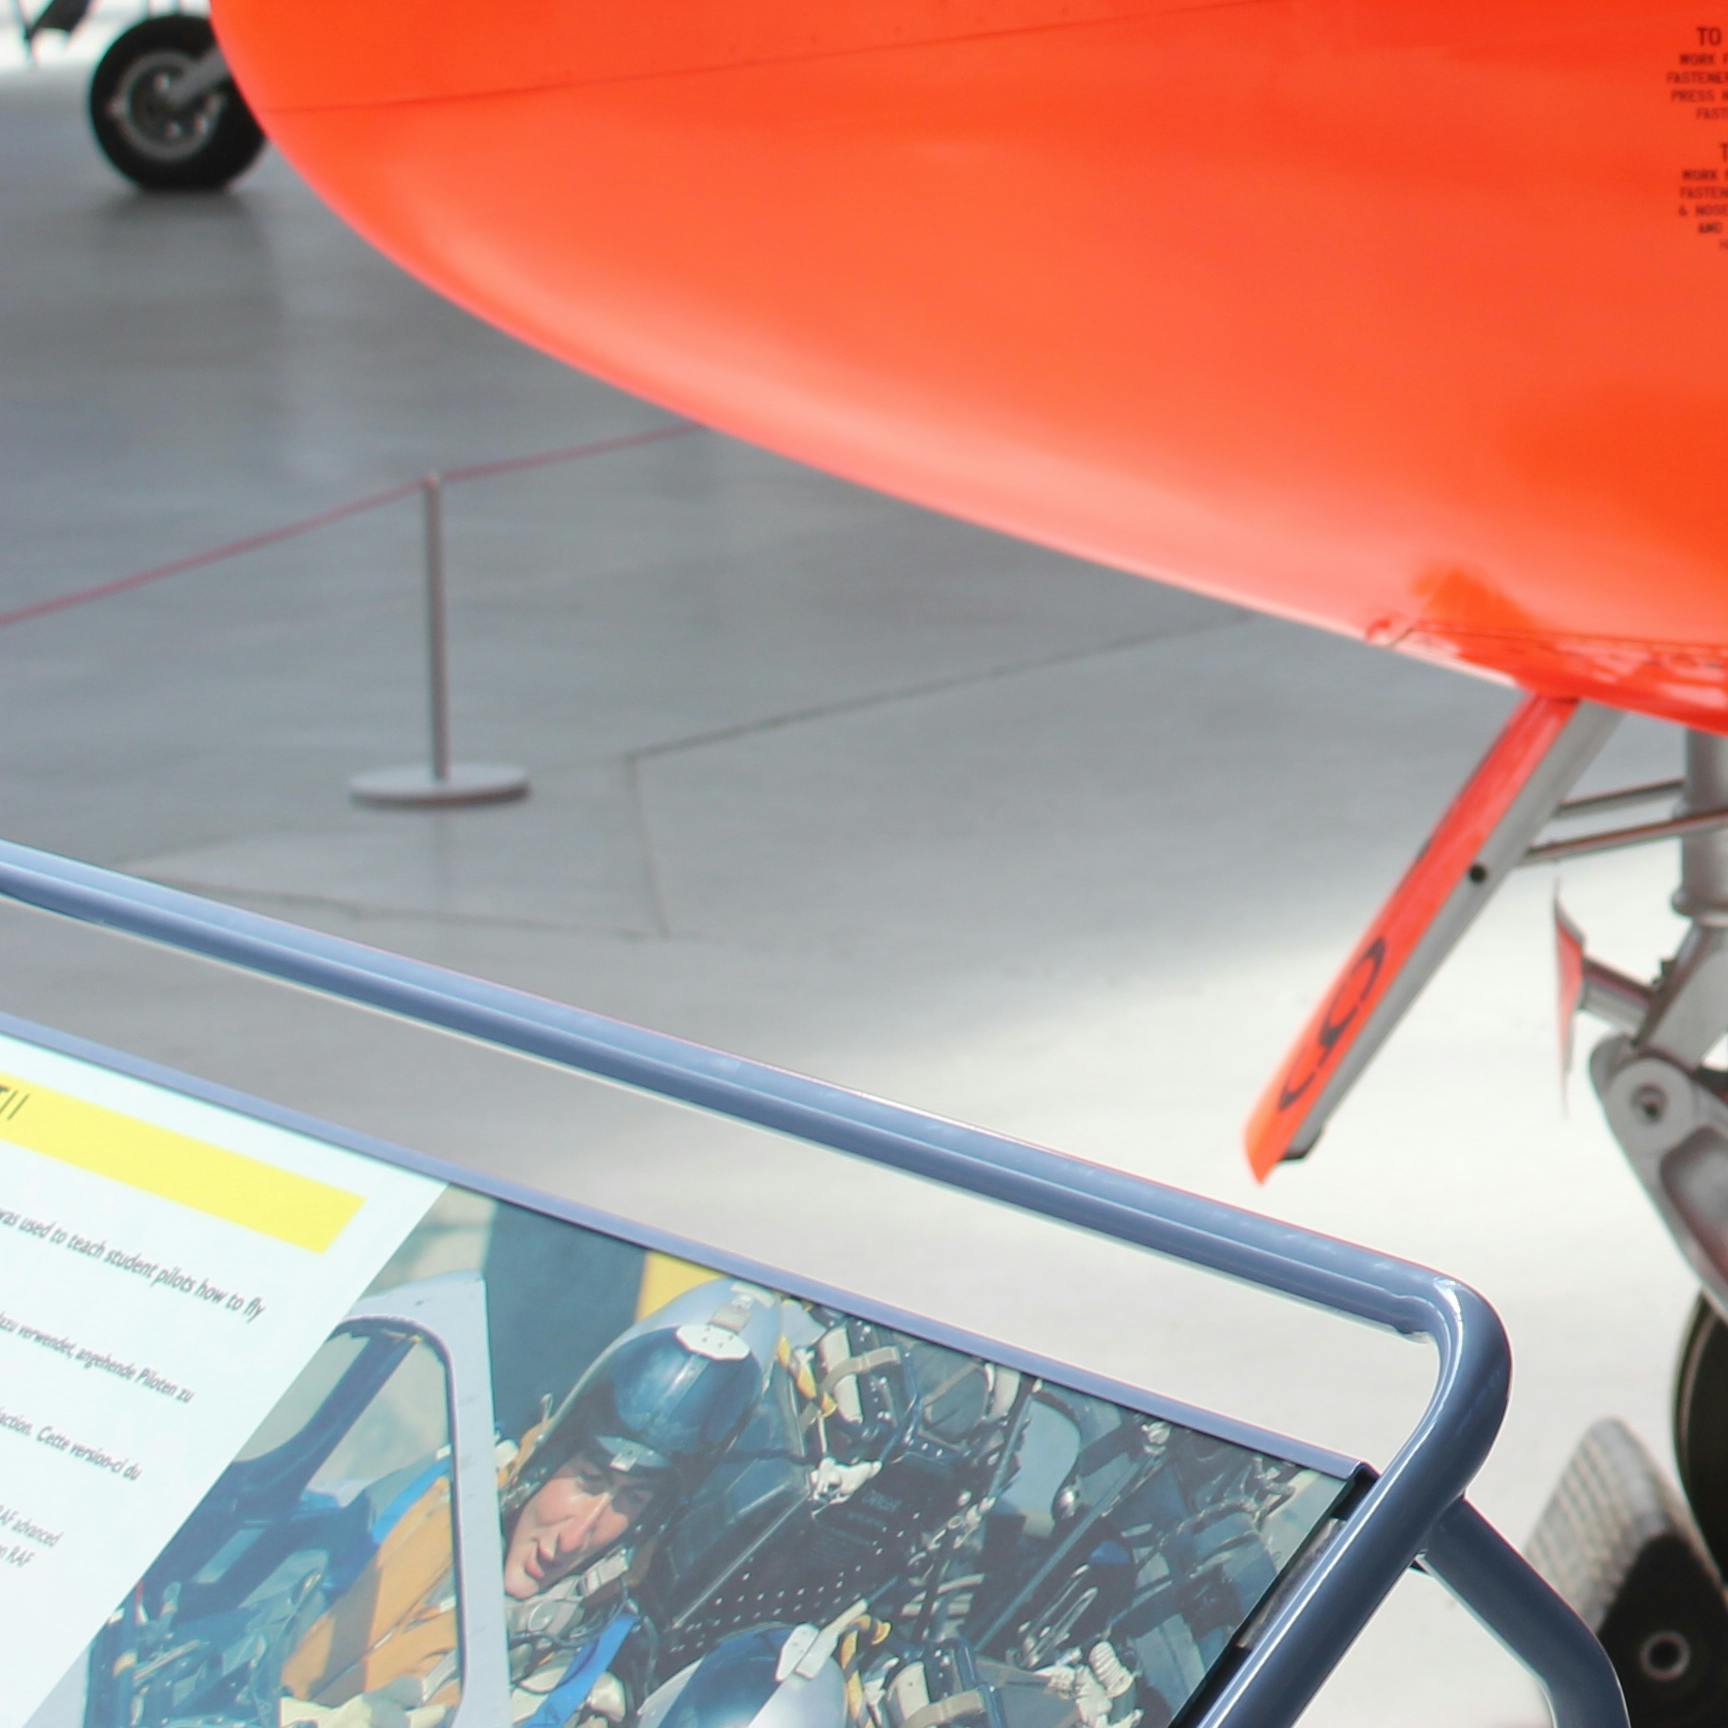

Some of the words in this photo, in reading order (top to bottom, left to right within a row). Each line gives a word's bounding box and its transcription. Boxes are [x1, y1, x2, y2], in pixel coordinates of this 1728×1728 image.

[1697, 26, 1722, 46] TO
[1679, 53, 1714, 65] WORK
[1671, 89, 1715, 101] PRESS
[1681, 168, 1717, 181] WORK
[1678, 205, 1688, 216] &
[1695, 204, 1728, 215] NOSE
[1697, 222, 1723, 234] AND
[18, 1218, 57, 1239] used
[49, 1227, 68, 1245] to
[66, 1234, 107, 1259] teach
[103, 1249, 160, 1279] student
[150, 1266, 197, 1293] pilots
[194, 1277, 226, 1304] how
[225, 1292, 245, 1311] to
[242, 1295, 266, 1324] fly
[18, 1325, 77, 1358] verwendet,
[75, 1348, 137, 1380] angehende
[135, 1368, 178, 1397] Piloten
[175, 1388, 195, 1403] zu
[37, 1425, 70, 1451] Cette
[70, 1443, 128, 1474] version-ci
[123, 1462, 142, 1481] du
